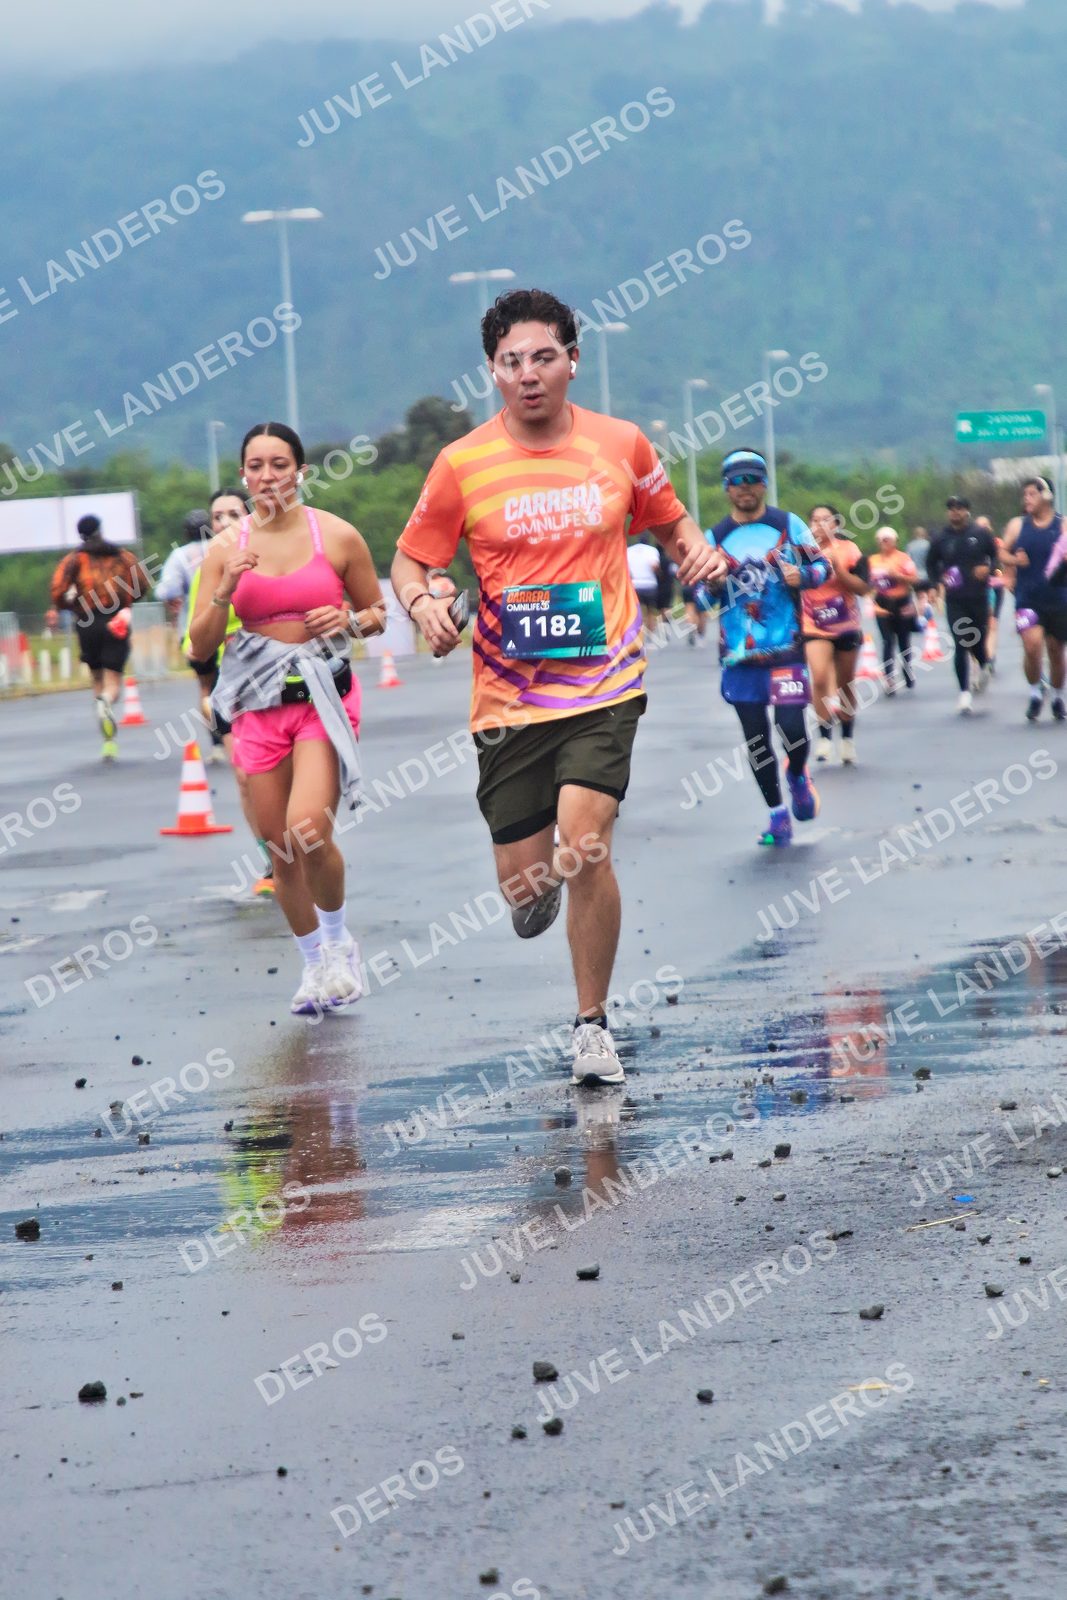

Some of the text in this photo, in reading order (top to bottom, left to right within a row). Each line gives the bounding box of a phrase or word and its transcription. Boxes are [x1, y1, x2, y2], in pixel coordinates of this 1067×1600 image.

[504, 483, 601, 522] CARRERA
[506, 512, 581, 538] OMNILIFE
[506, 590, 550, 603] CARRERA
[578, 587, 595, 603] 10K
[506, 602, 540, 612] OMNILIFE
[519, 614, 582, 637] 1182
